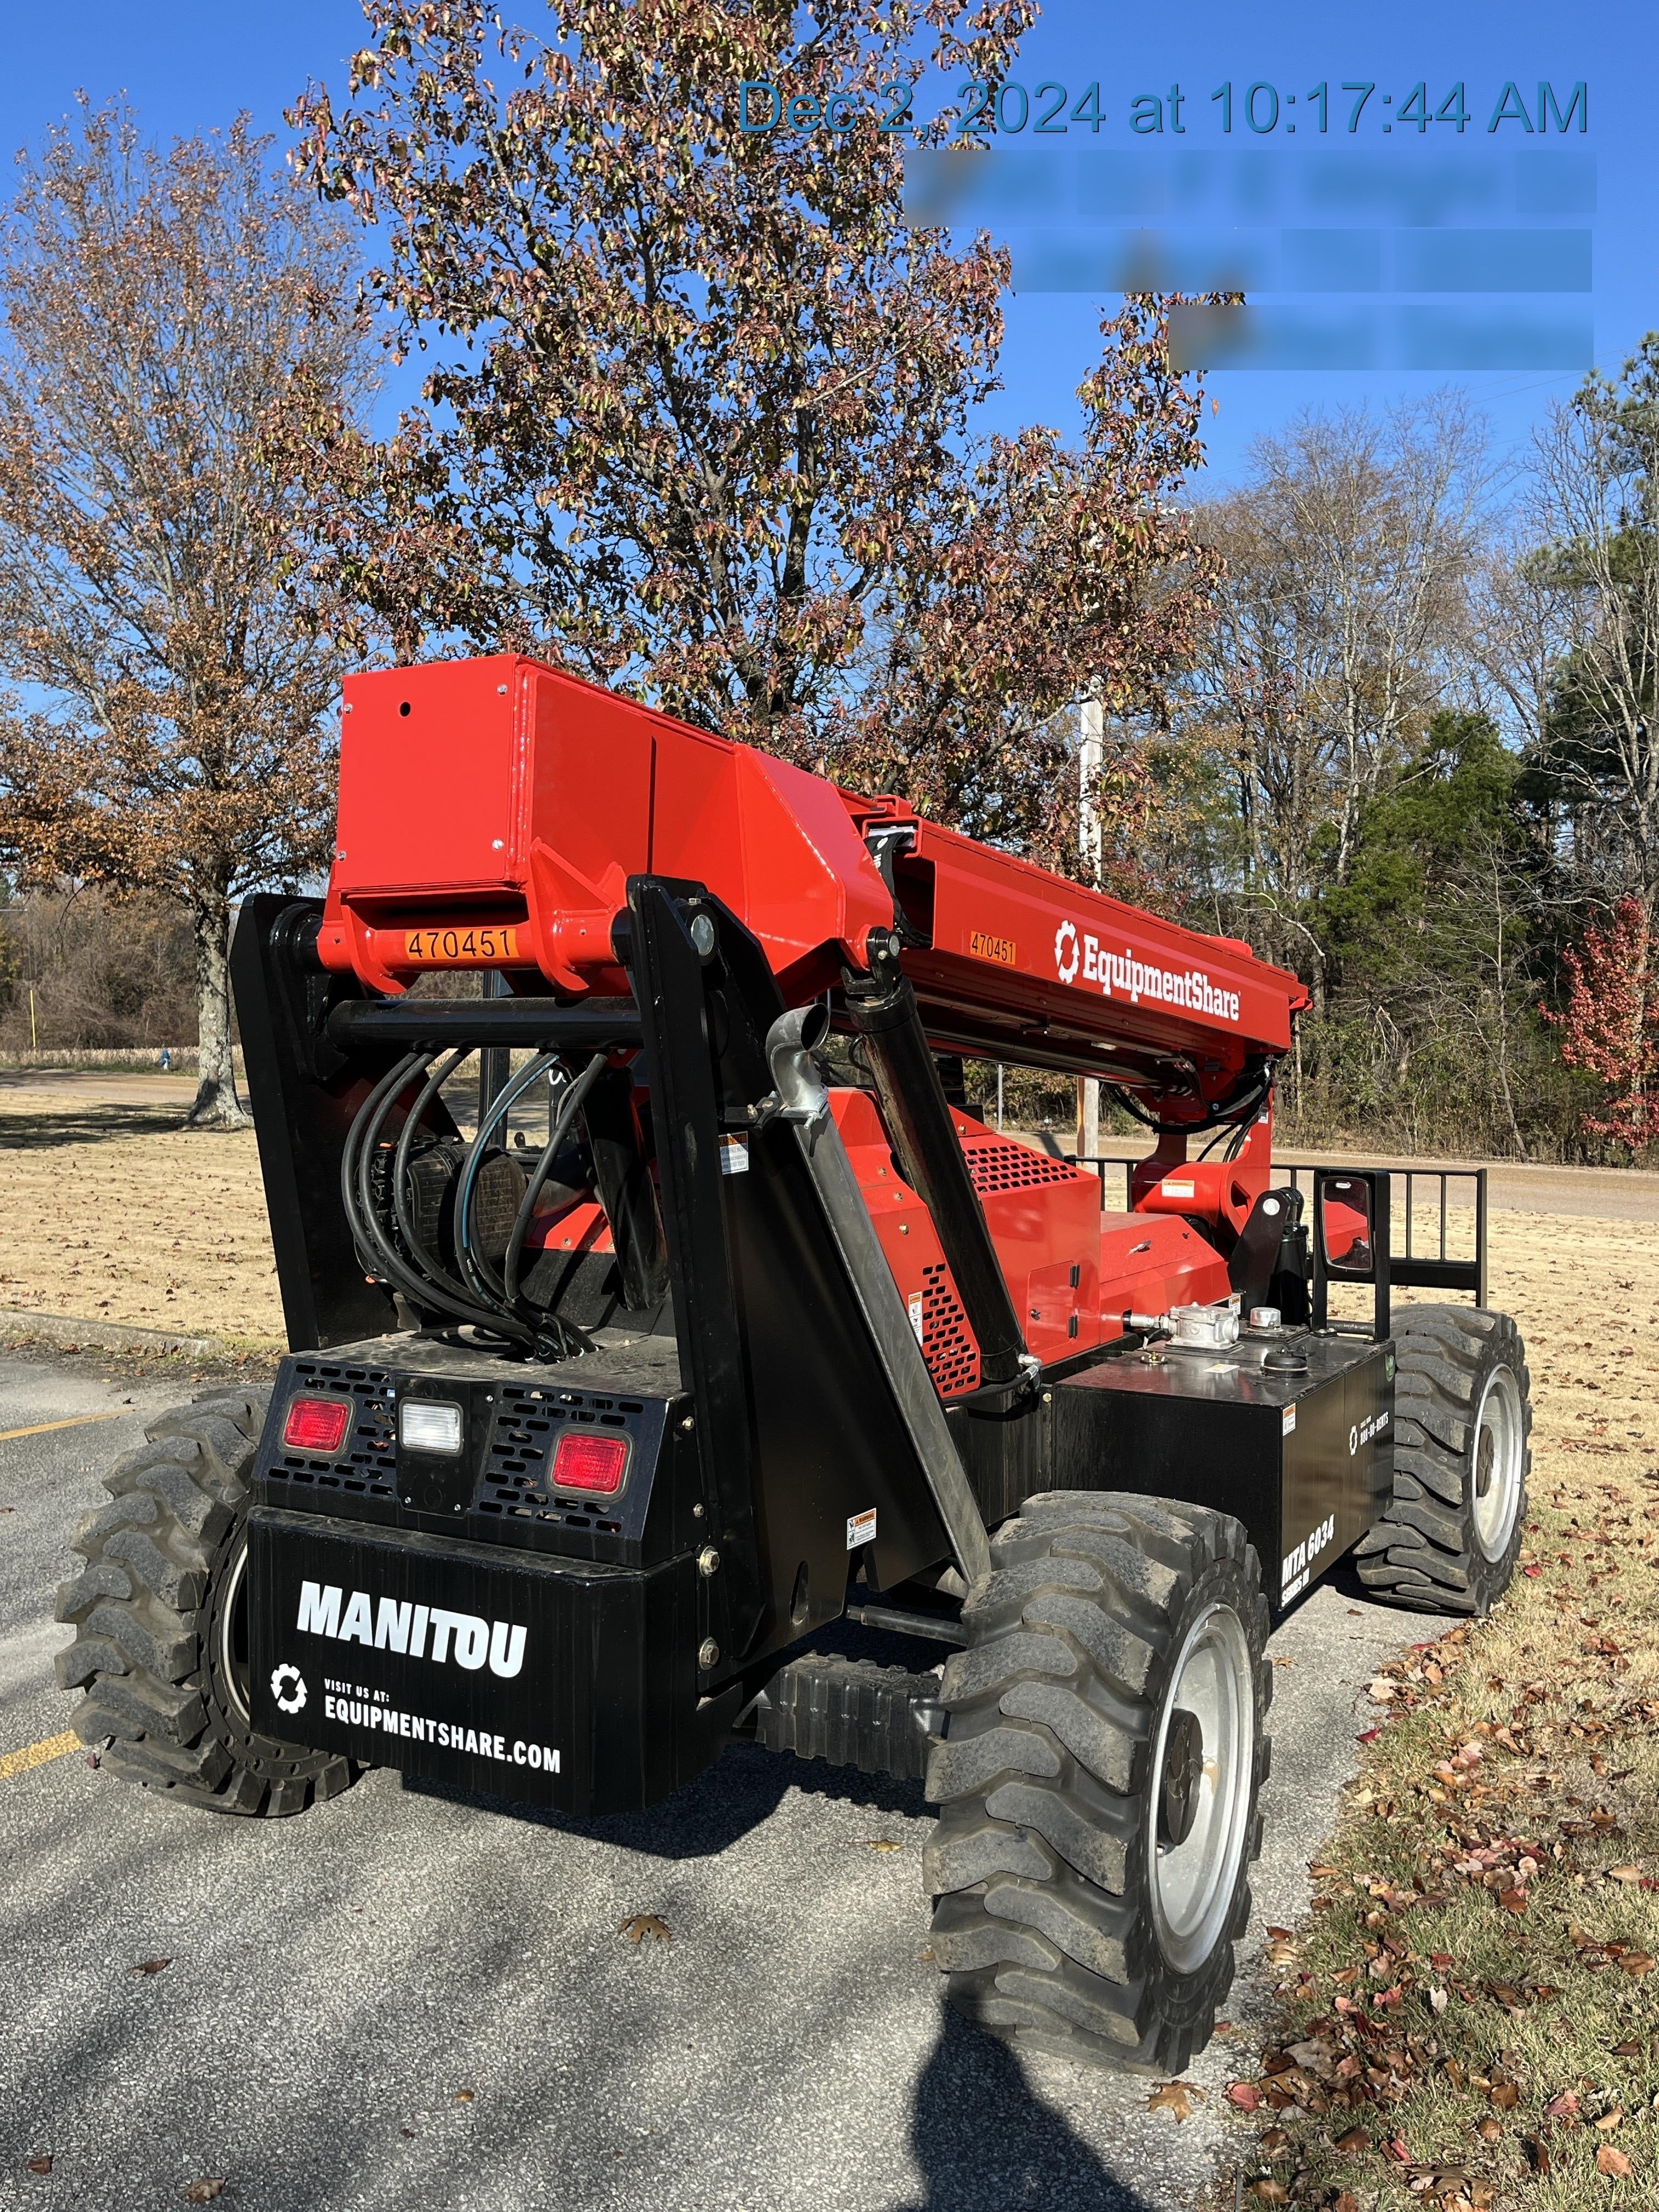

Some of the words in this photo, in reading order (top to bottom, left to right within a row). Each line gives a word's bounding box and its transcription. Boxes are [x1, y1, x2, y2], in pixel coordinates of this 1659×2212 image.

[409, 930, 510, 958] 470451
[972, 933, 1013, 963] 470451
[1082, 934, 1239, 1022] EquipmentShare
[859, 1513, 874, 1521] WARNING
[1282, 1541, 1306, 1587] MTA
[1307, 1514, 1334, 1561] 6034
[297, 1580, 527, 1678] MANITOU
[324, 1678, 352, 1695] VISIT
[356, 1685, 369, 1699] US
[374, 1690, 390, 1702] AT:
[325, 1695, 560, 1774] EQUIPMENTSHARE.COM
